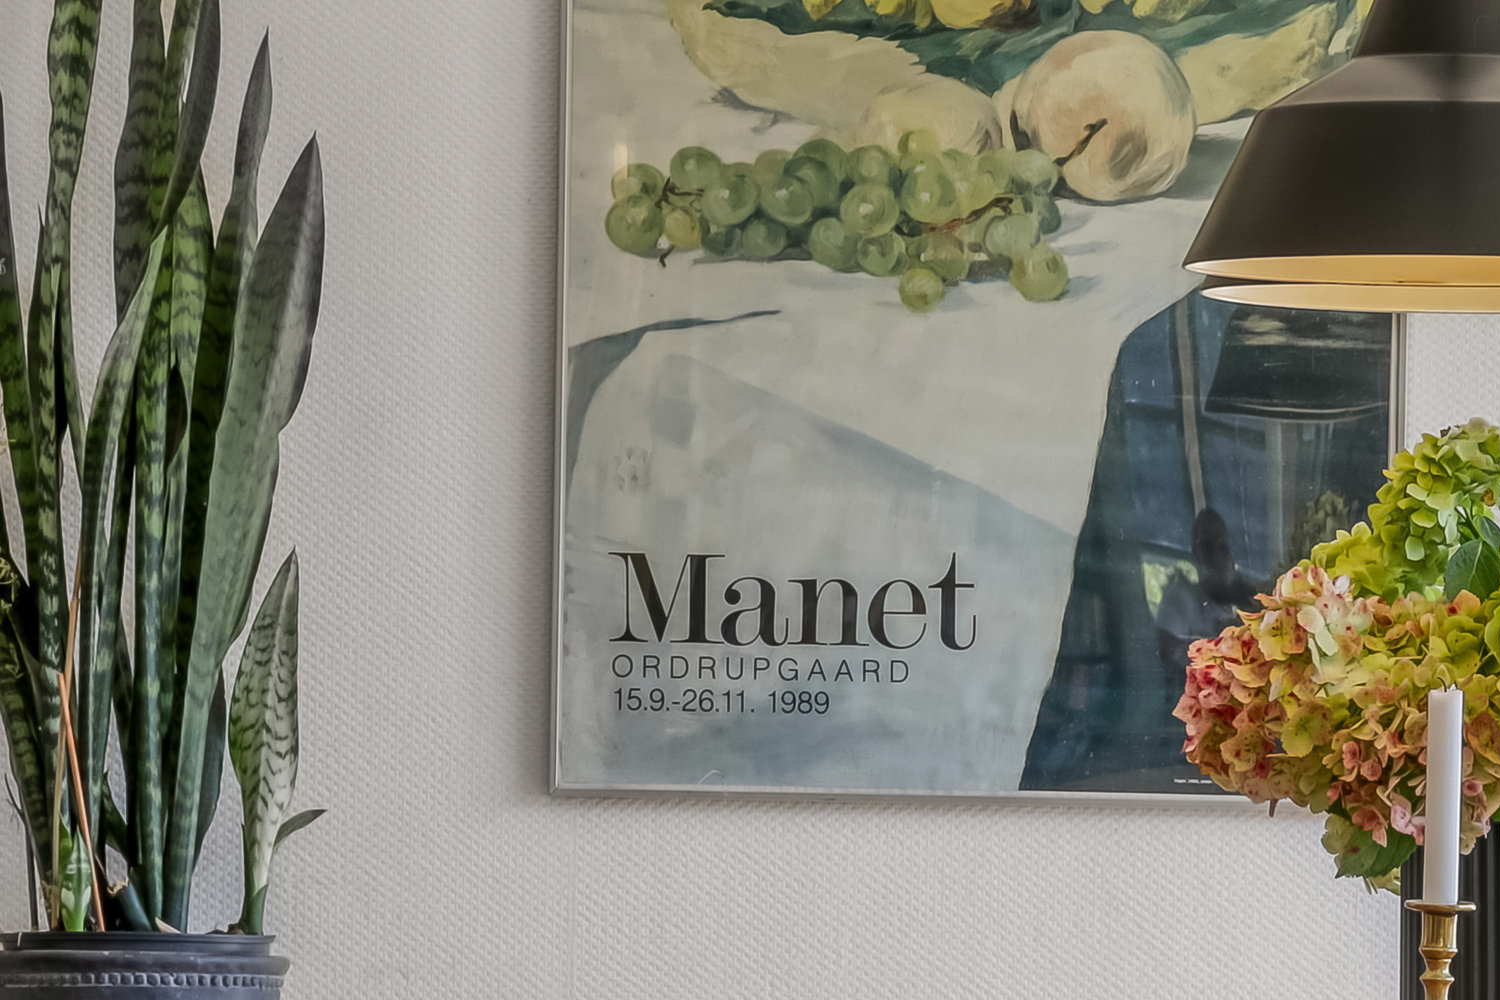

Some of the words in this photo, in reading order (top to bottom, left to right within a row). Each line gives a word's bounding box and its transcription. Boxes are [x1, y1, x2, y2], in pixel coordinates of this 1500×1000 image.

[608, 552, 977, 651] Manet
[611, 654, 910, 683] ORDRUPGAARD
[613, 688, 756, 713] 15.9.-26.11.
[768, 690, 831, 715] 1989
